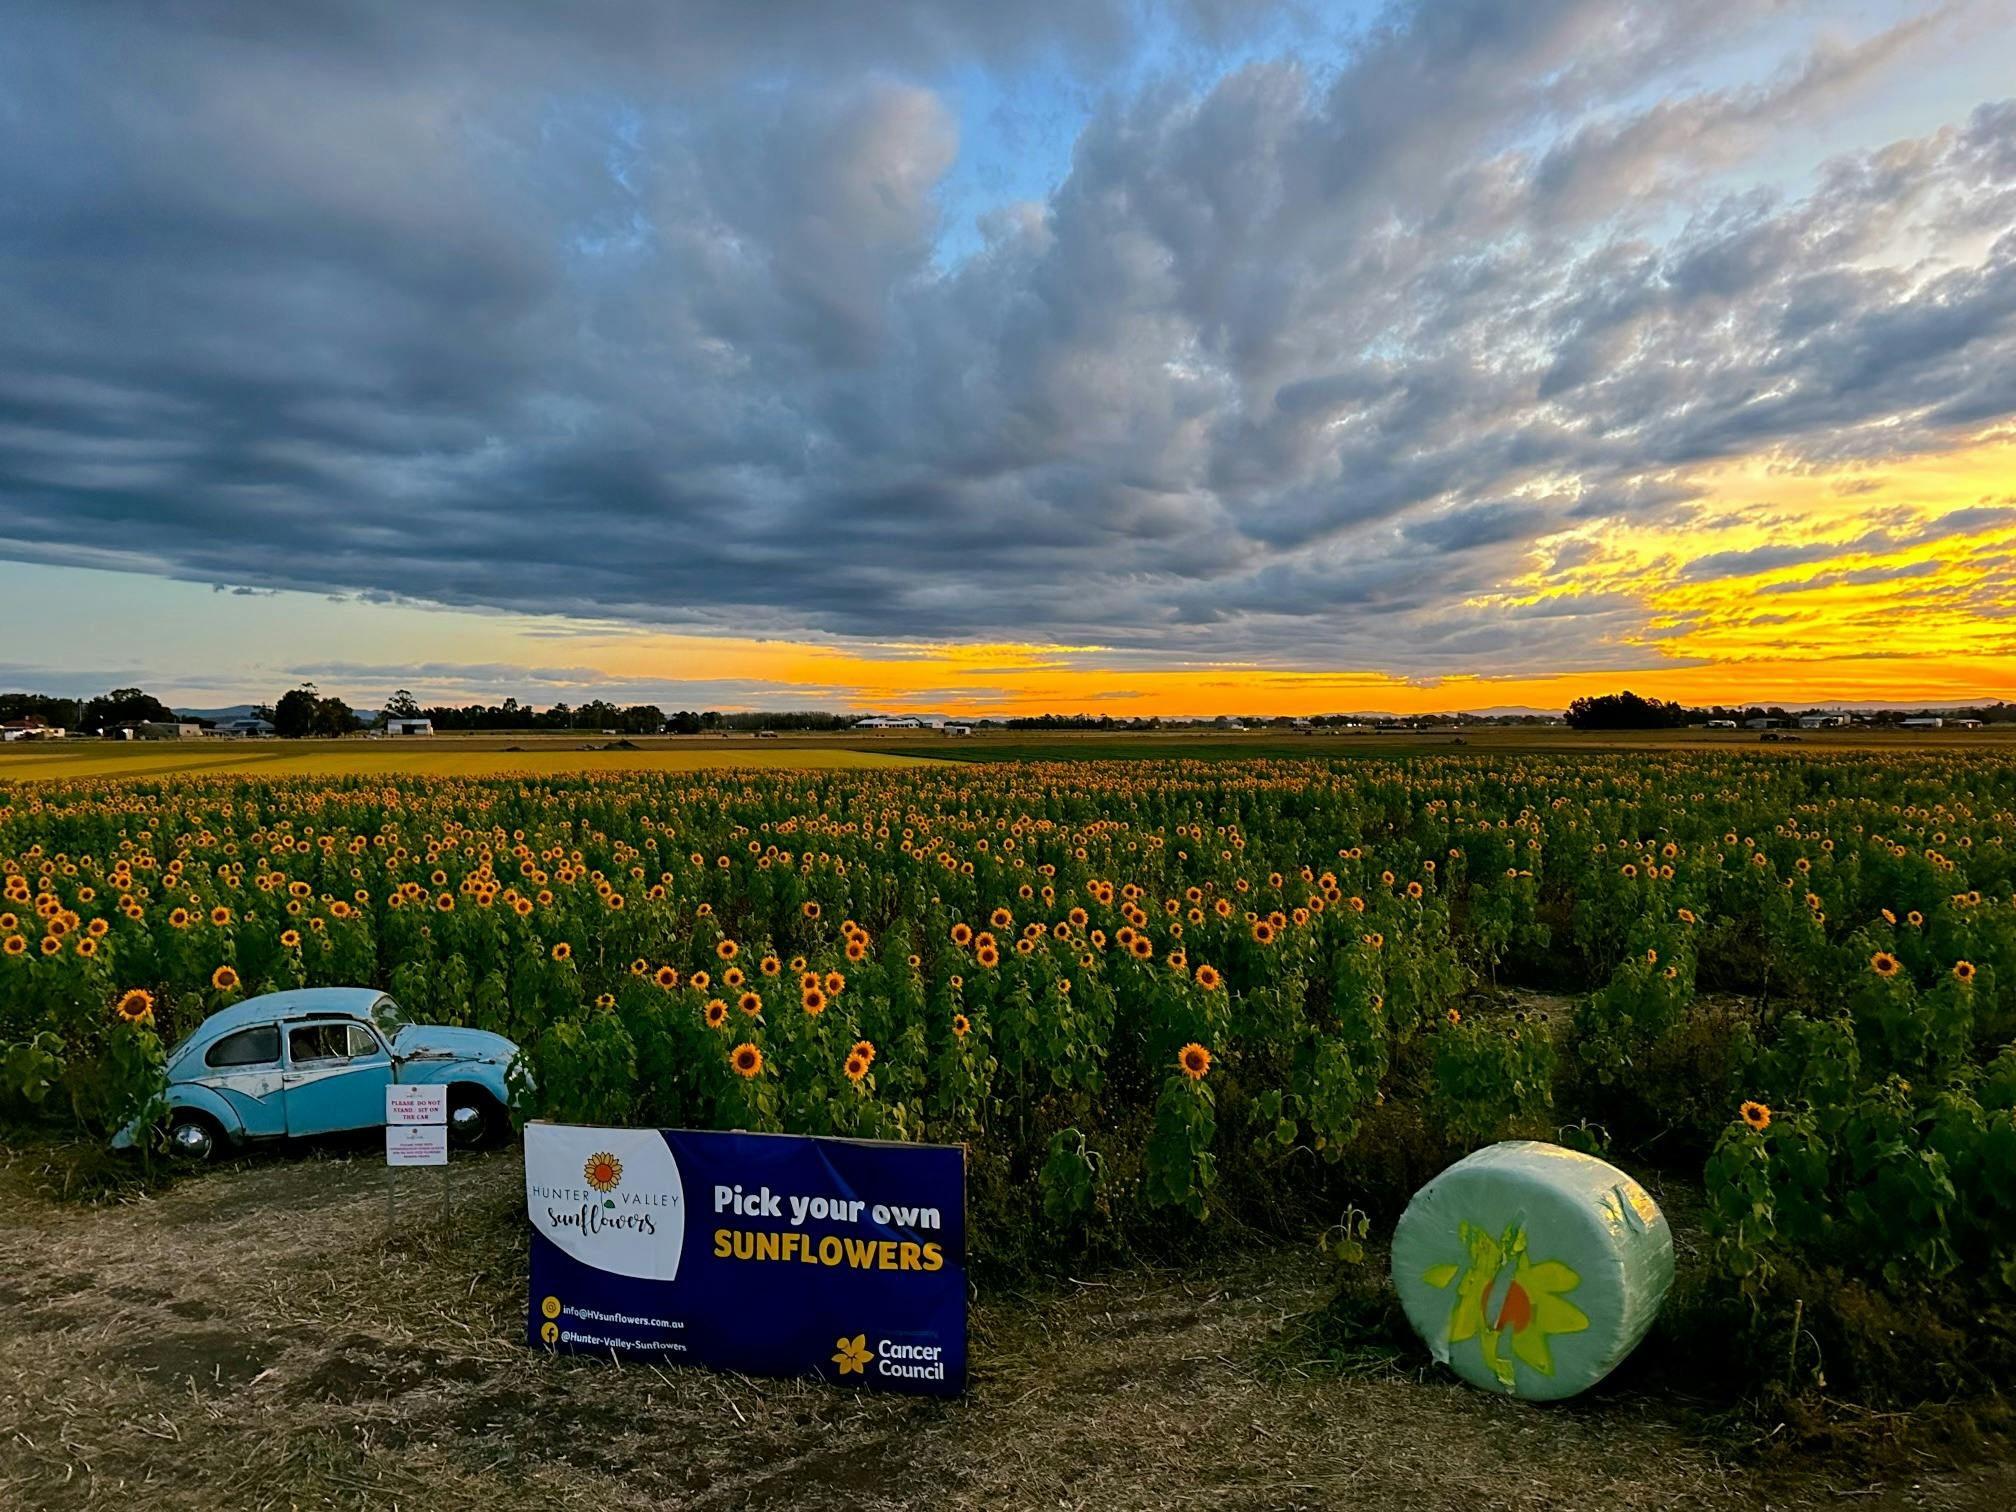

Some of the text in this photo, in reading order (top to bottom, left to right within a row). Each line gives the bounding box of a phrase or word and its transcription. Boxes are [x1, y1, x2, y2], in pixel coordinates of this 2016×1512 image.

[532, 1185, 679, 1207] HUNTER VALLEY
[714, 1184, 941, 1230] Pick your own
[713, 1228, 944, 1271] SUNFLOWERS
[563, 1304, 684, 1329] info@HVsunflowers.com.au
[561, 1331, 687, 1352] @Hunter-Valley-Sunflowers
[878, 1339, 942, 1361] Cancer
[878, 1359, 944, 1380] Council
